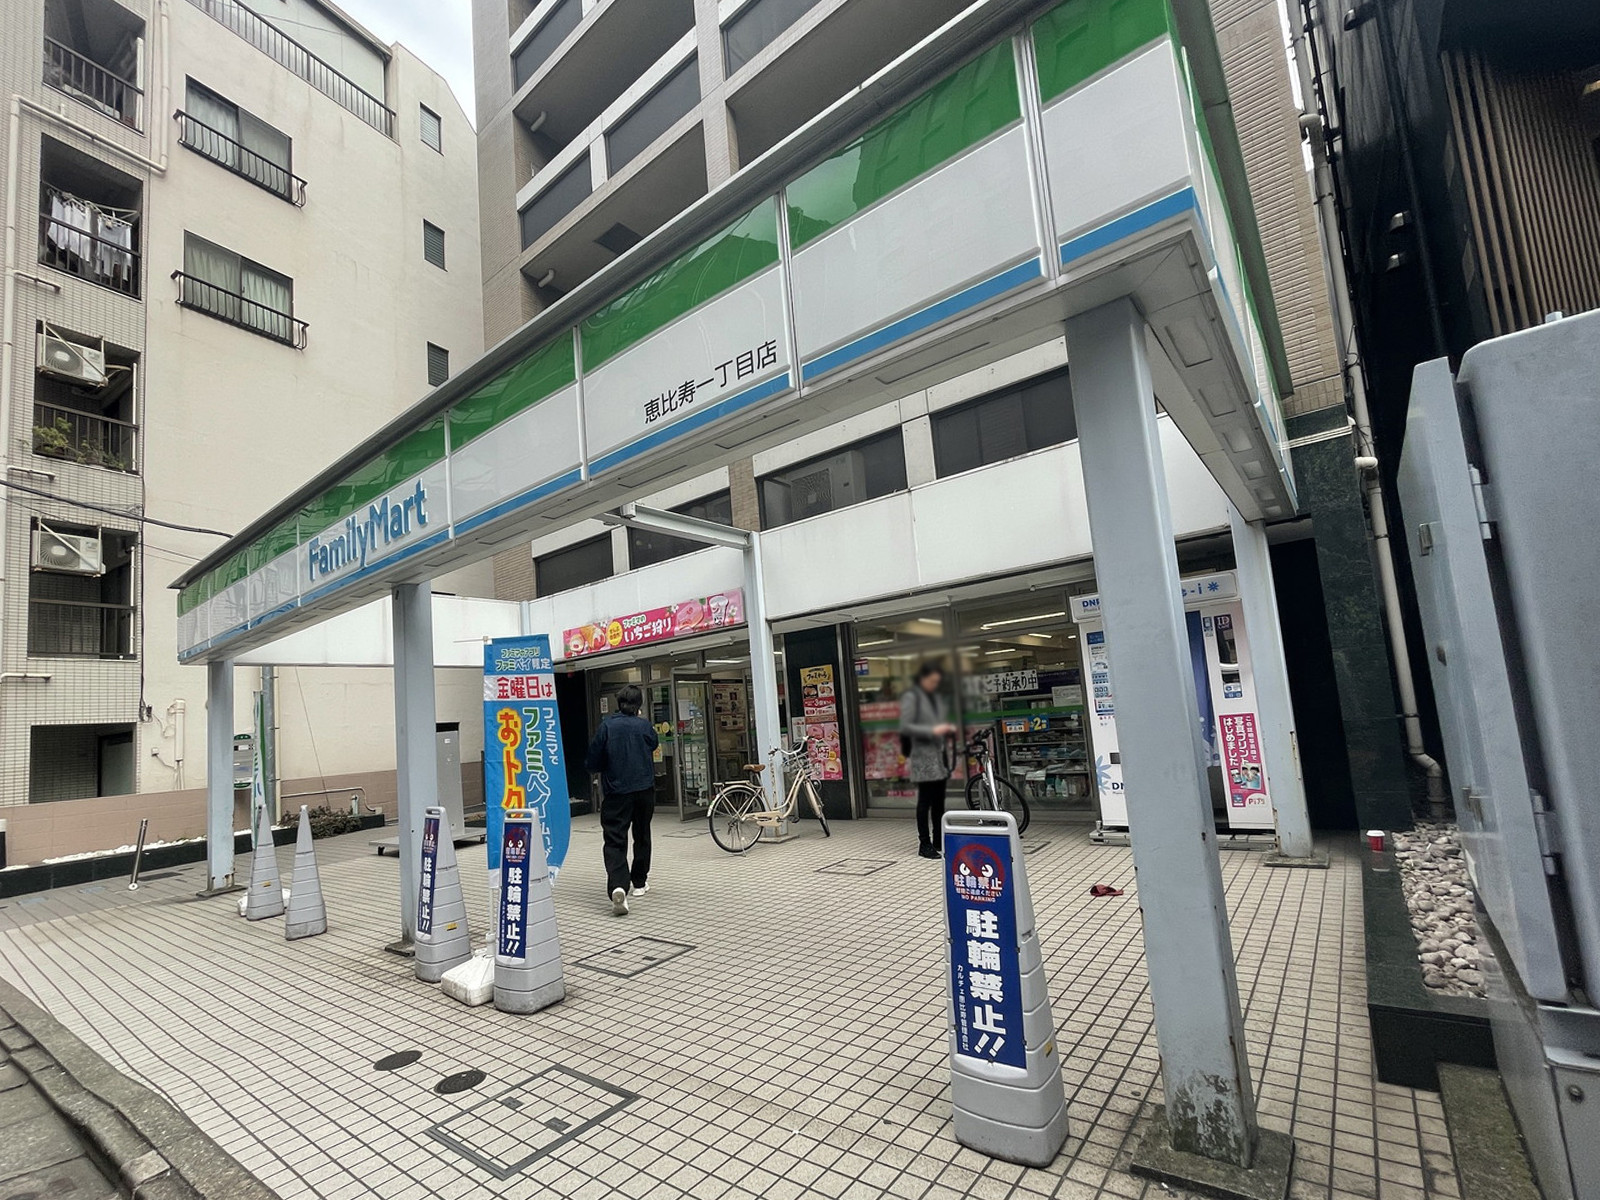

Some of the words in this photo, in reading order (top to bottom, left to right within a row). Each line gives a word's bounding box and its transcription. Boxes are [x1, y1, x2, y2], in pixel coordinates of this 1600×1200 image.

[644, 339, 777, 424] 恵比寿一丁目店
[309, 477, 428, 582] FamilyMart
[624, 617, 672, 642] いちご狩り
[497, 676, 553, 699] 金曜日は
[542, 707, 559, 765] ファミマで
[1223, 717, 1239, 766] はじめました
[1234, 716, 1250, 765] 写真プリント
[954, 874, 1003, 890] 駐輪禁止
[970, 895, 996, 903] PARKING
[965, 908, 1007, 1057] 駐輪禁止!!
